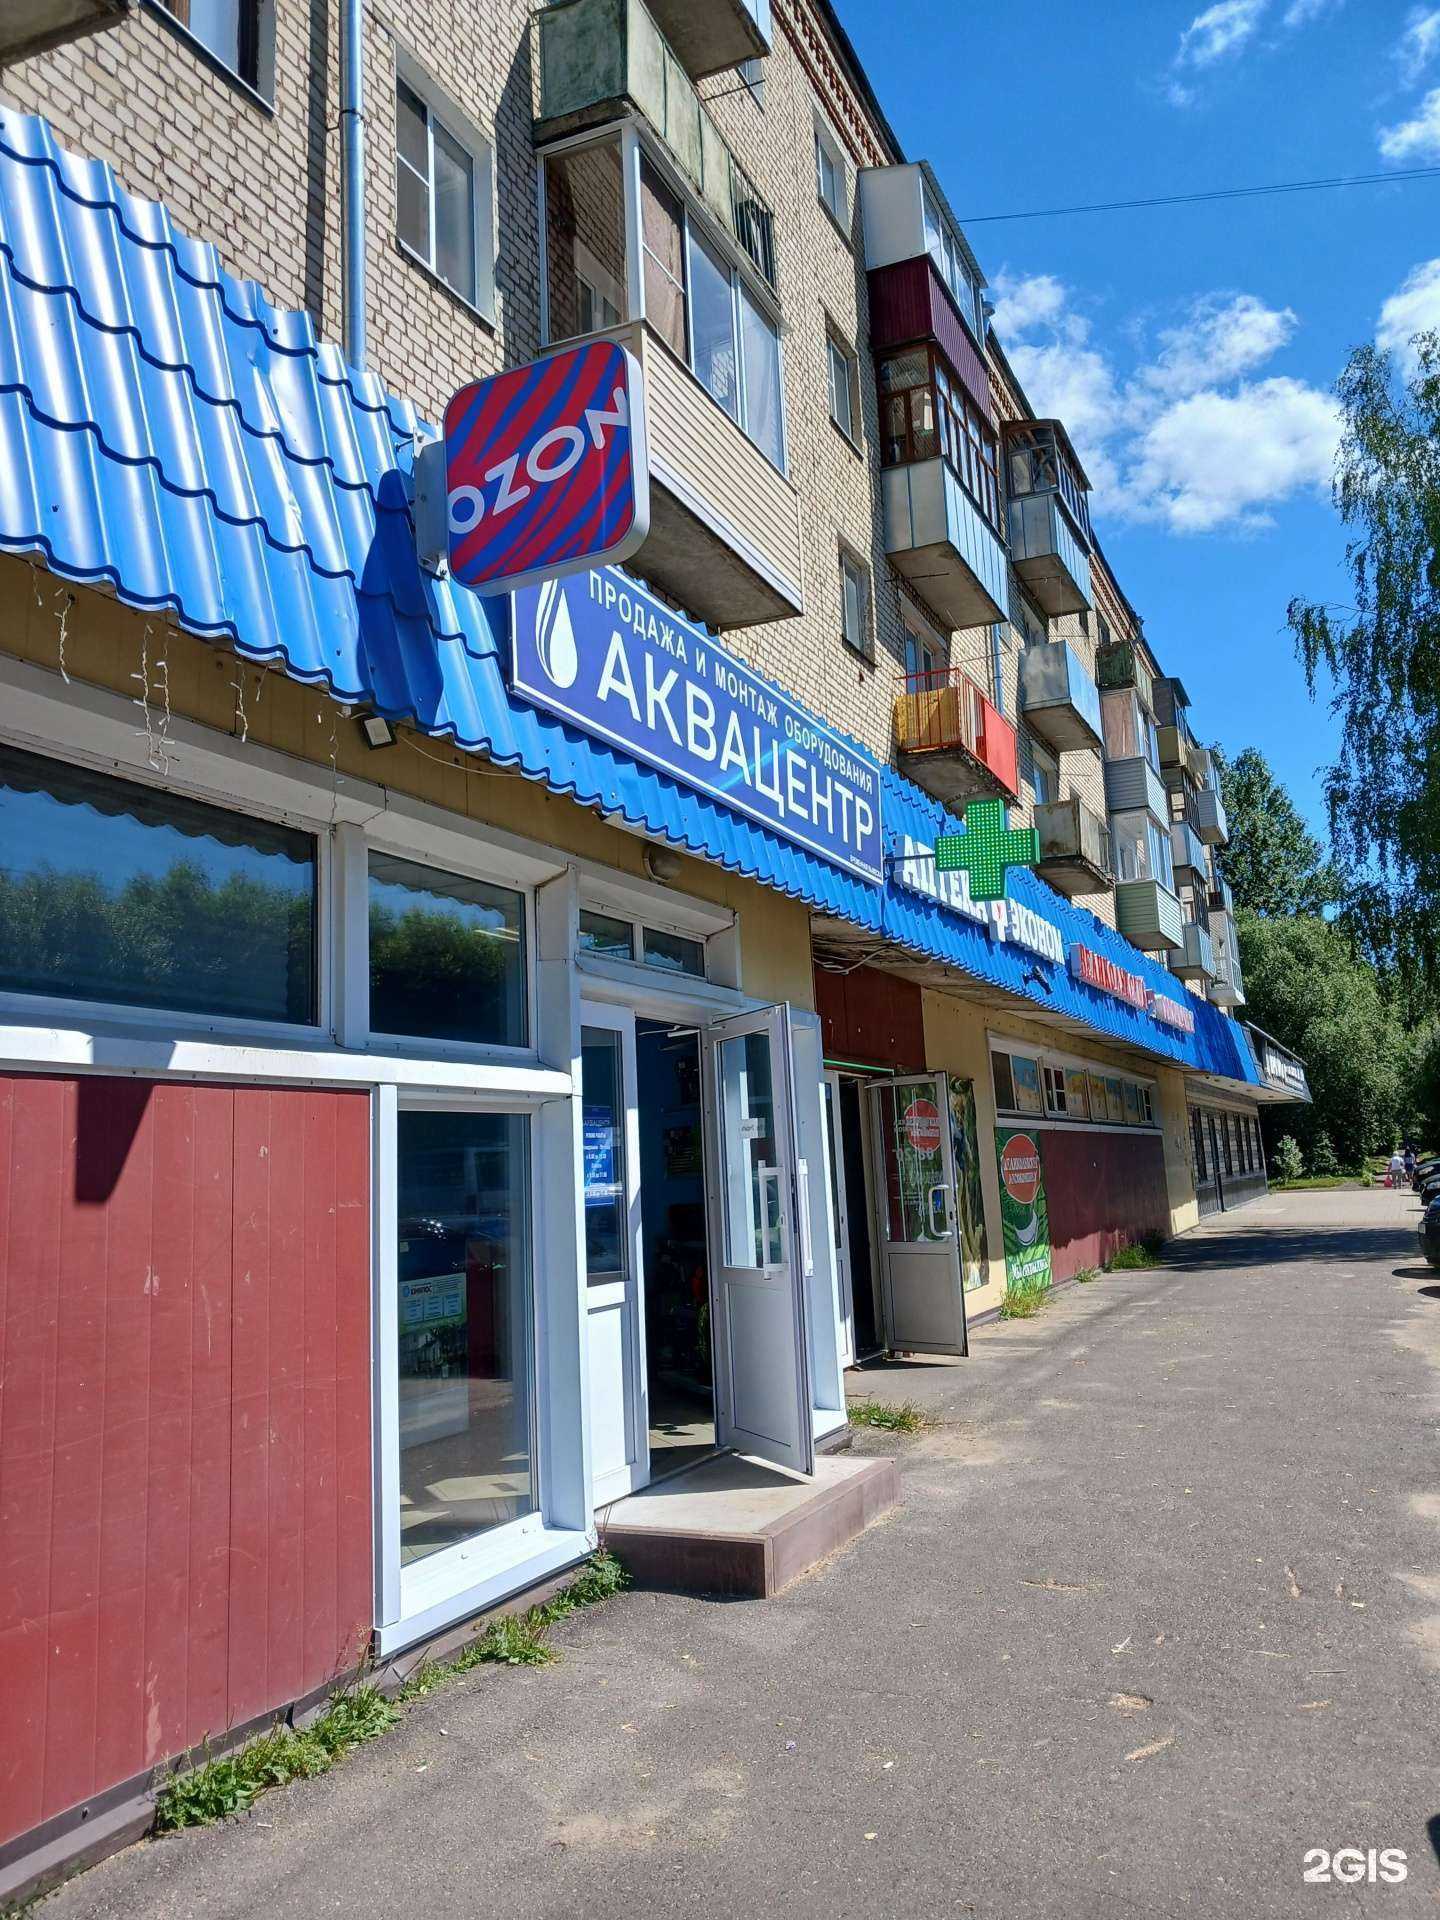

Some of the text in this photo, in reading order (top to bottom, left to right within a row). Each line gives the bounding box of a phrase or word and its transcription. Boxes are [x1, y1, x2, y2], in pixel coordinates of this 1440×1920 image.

[447, 387, 631, 534] OZON
[590, 569, 873, 795] ПРОДАЖА И МОНТАЖ ОБОРУДОВАНИЯ
[596, 630, 874, 853] АКВАЦЕНТР
[1009, 897, 1066, 966] ЭКОНОМ
